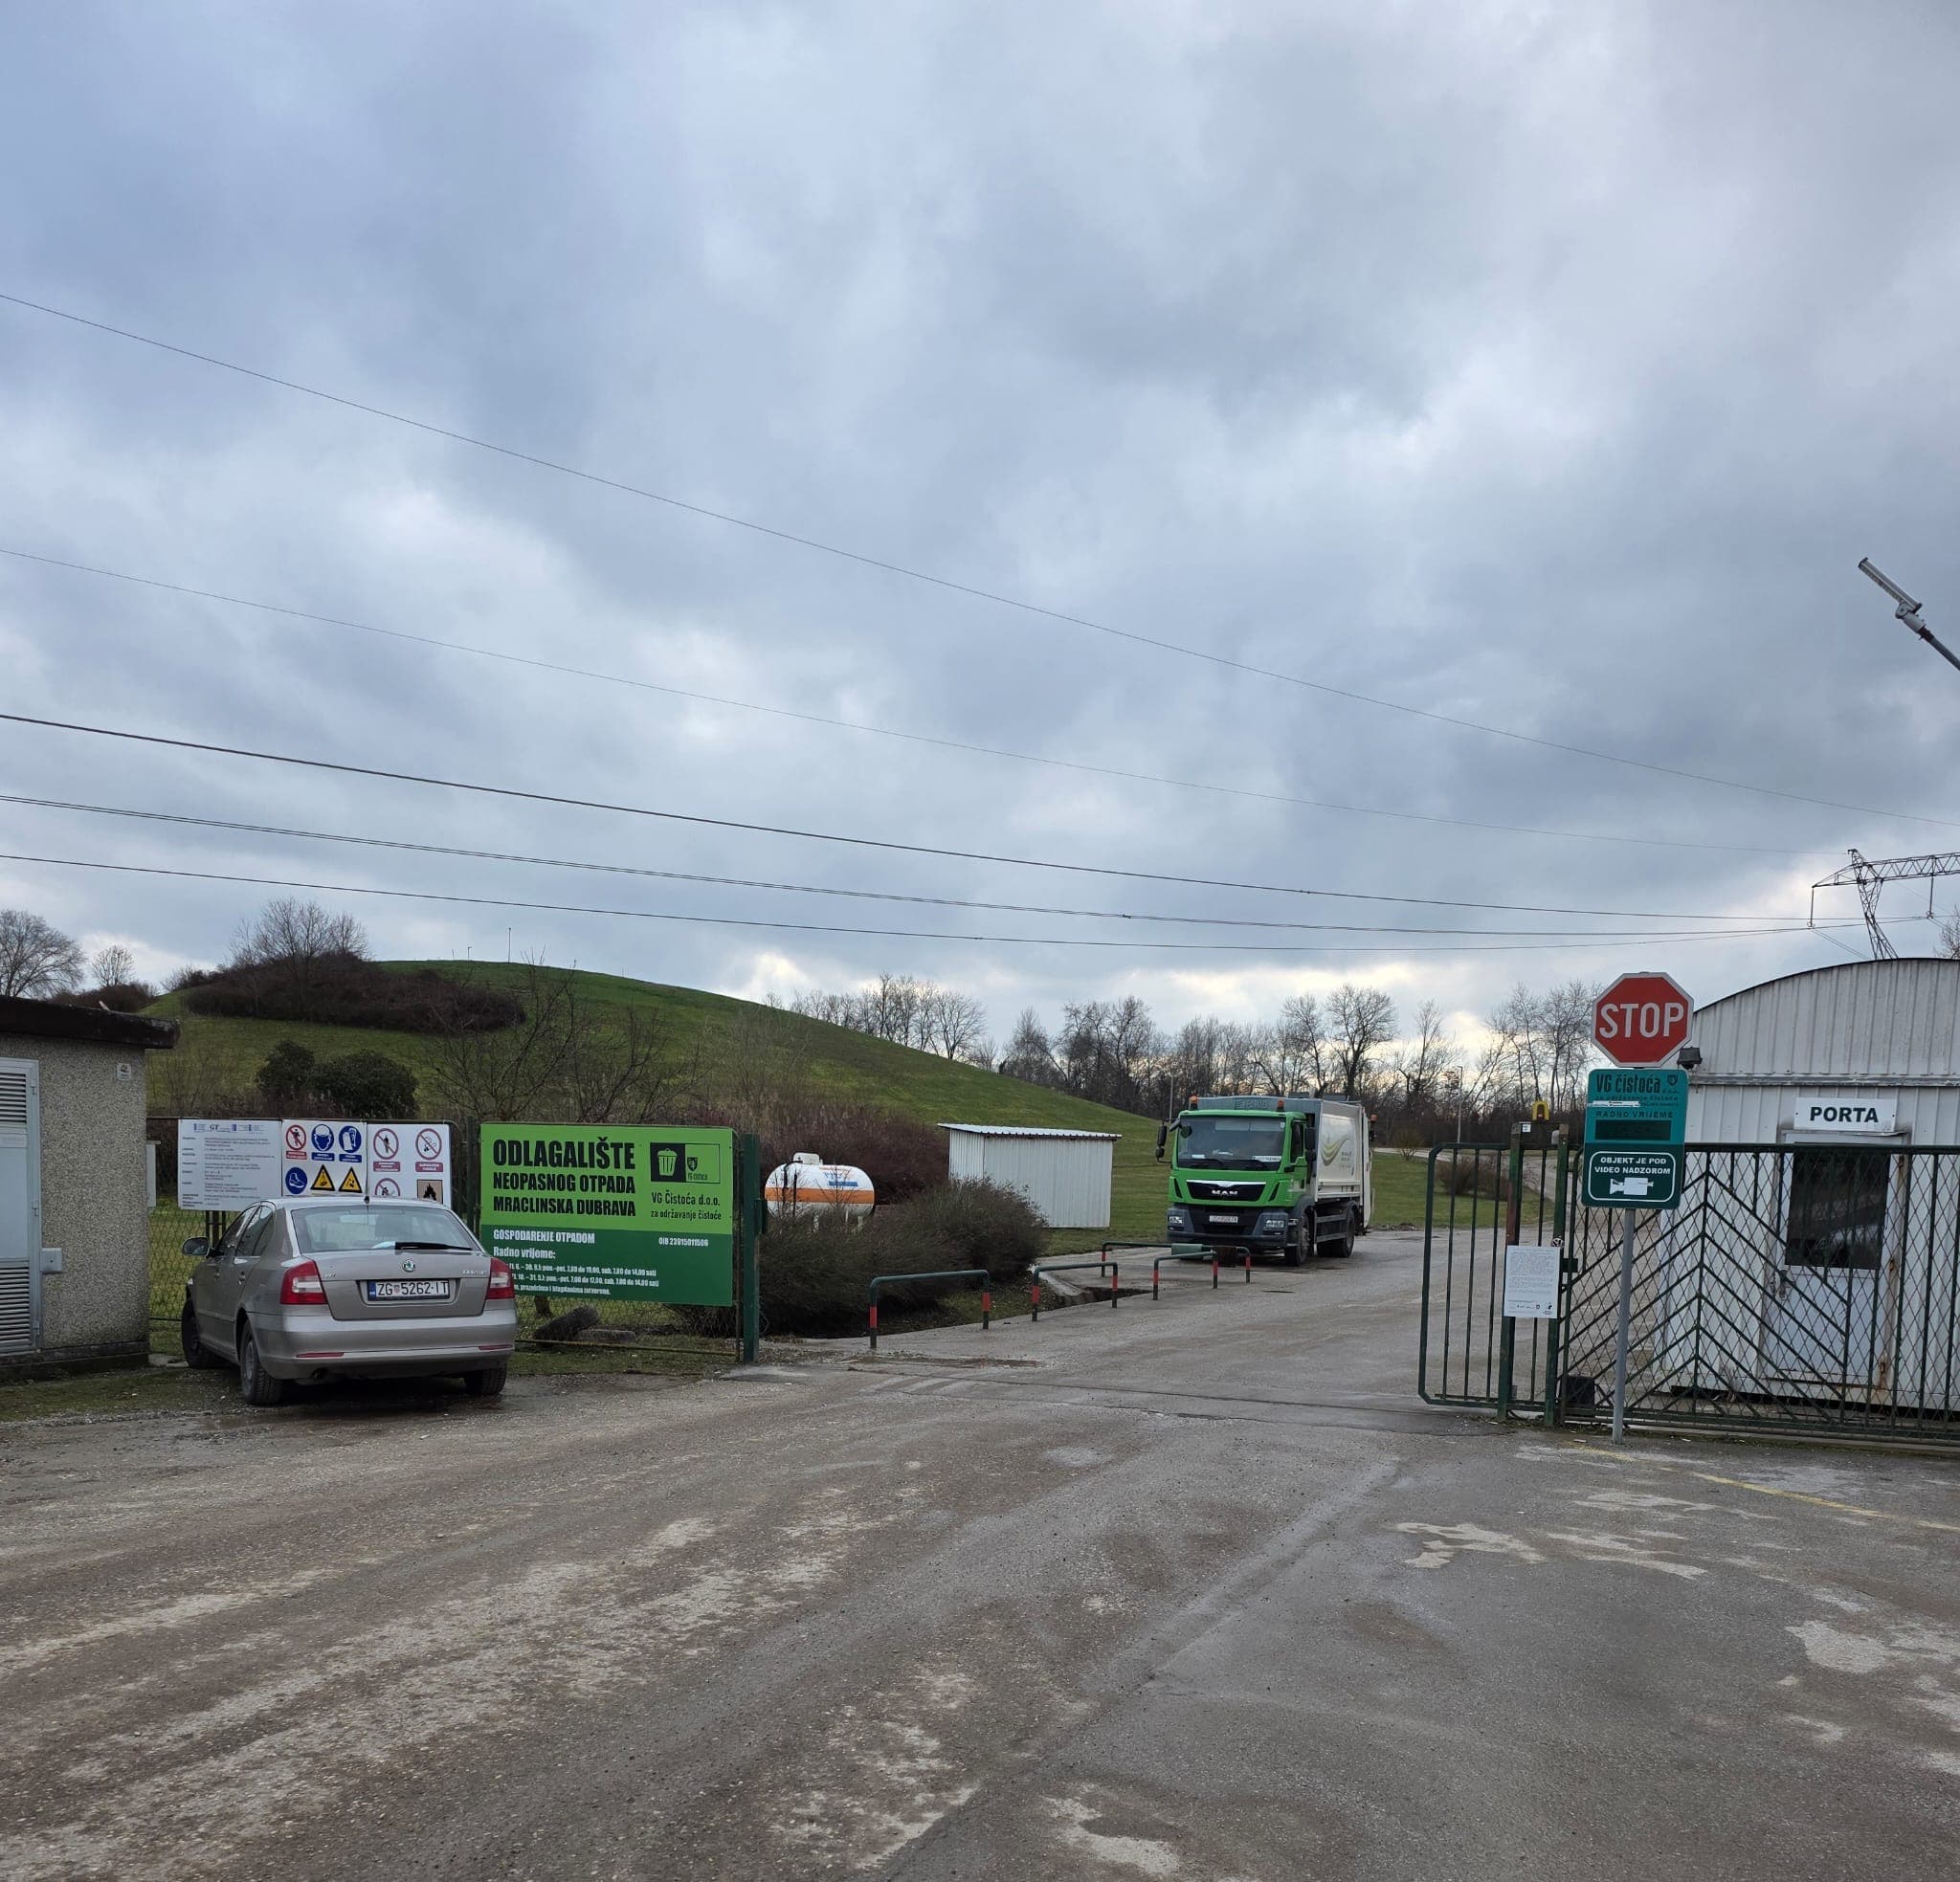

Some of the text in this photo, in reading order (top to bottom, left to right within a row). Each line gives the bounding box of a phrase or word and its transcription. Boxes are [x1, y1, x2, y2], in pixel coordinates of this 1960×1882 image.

[1599, 1003, 1684, 1039] STOP
[1596, 1074, 1661, 1094] VG čistoća
[1810, 1106, 1879, 1123] PORTA
[493, 1136, 635, 1169] ODLAGALIŠTE
[493, 1172, 635, 1194] NEOPASNOG OTPADA
[652, 1189, 721, 1206] VG Čistoća d.o.o.
[493, 1196, 635, 1217] MRACLINSKA DUBRAVA
[660, 1209, 696, 1221] održavanje
[698, 1209, 722, 1220] čistoće
[493, 1229, 595, 1244] GOSPODARENJE OTPADOM
[658, 1237, 669, 1246] OIB
[493, 1246, 556, 1259] Radno vrijeme:
[377, 1283, 393, 1295] ZG
